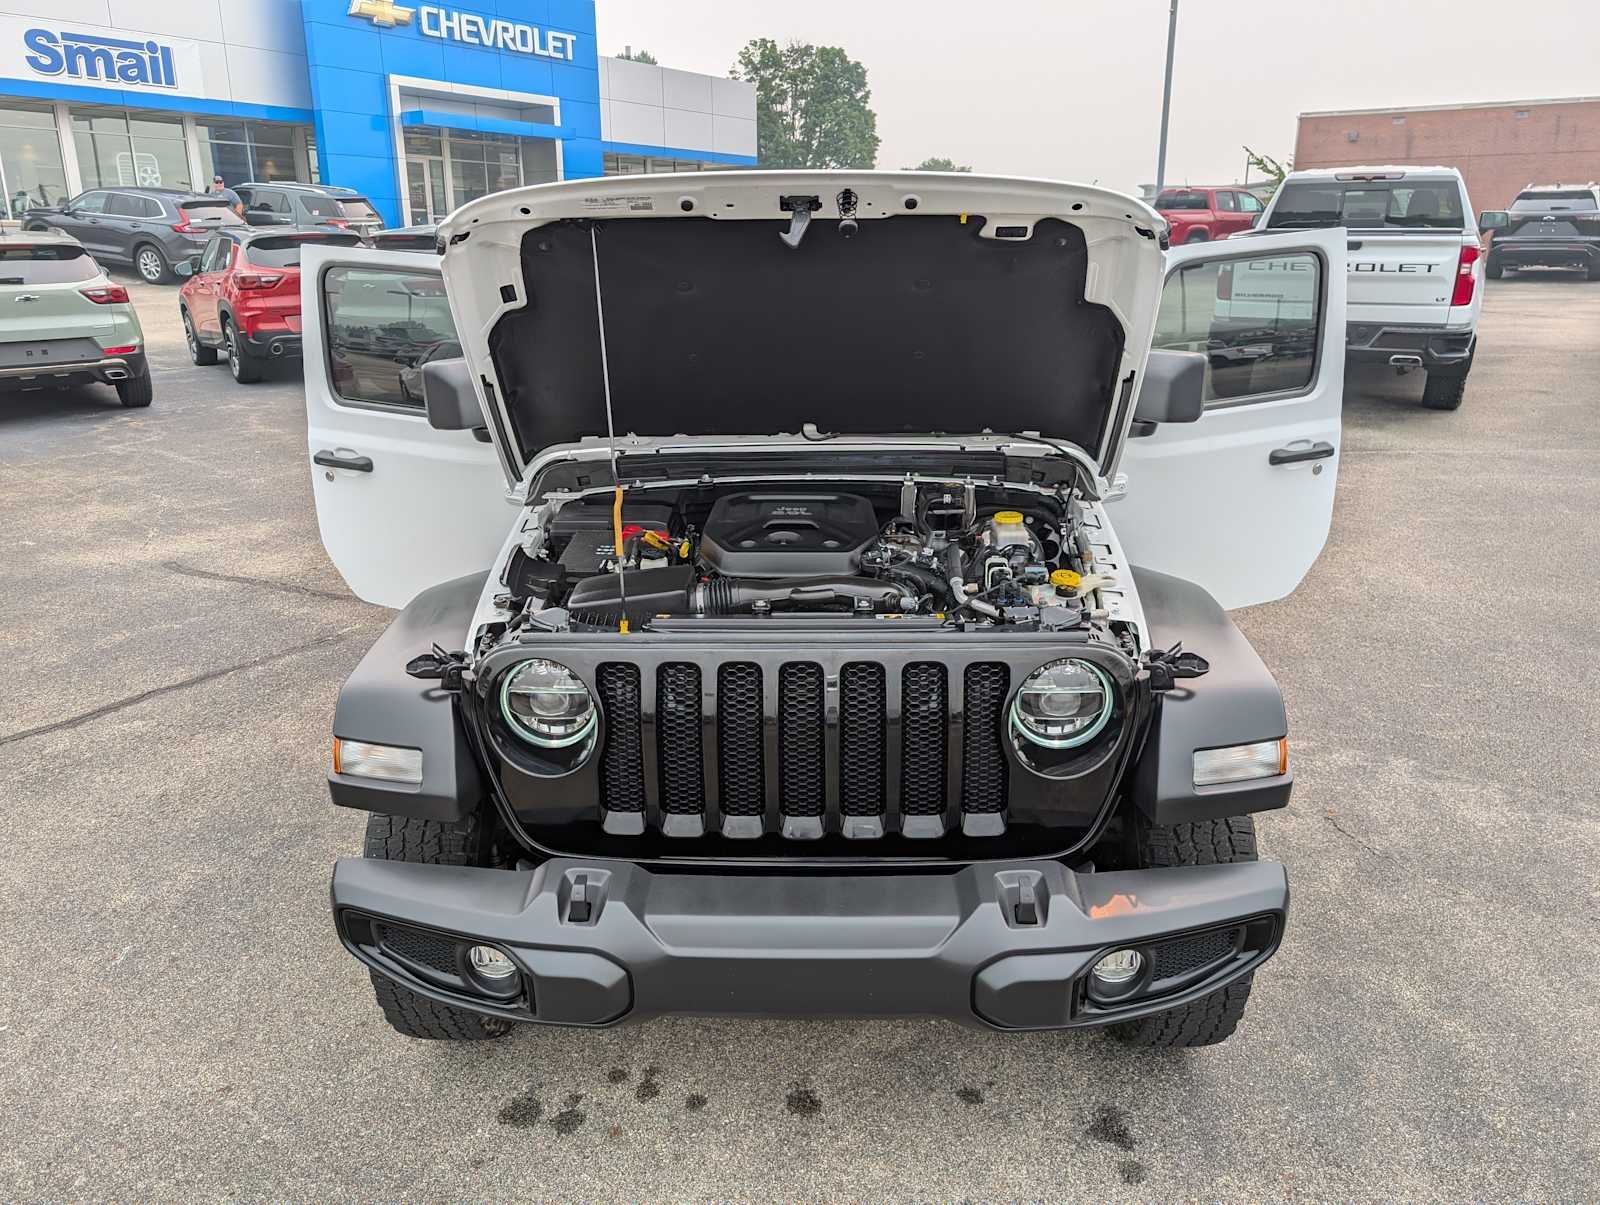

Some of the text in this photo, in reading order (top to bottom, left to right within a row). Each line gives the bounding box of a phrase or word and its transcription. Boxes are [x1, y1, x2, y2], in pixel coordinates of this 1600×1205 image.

[23, 28, 178, 90] Smail
[420, 5, 577, 61] CHEVROLET
[1249, 261, 1441, 273] CHEOLET
